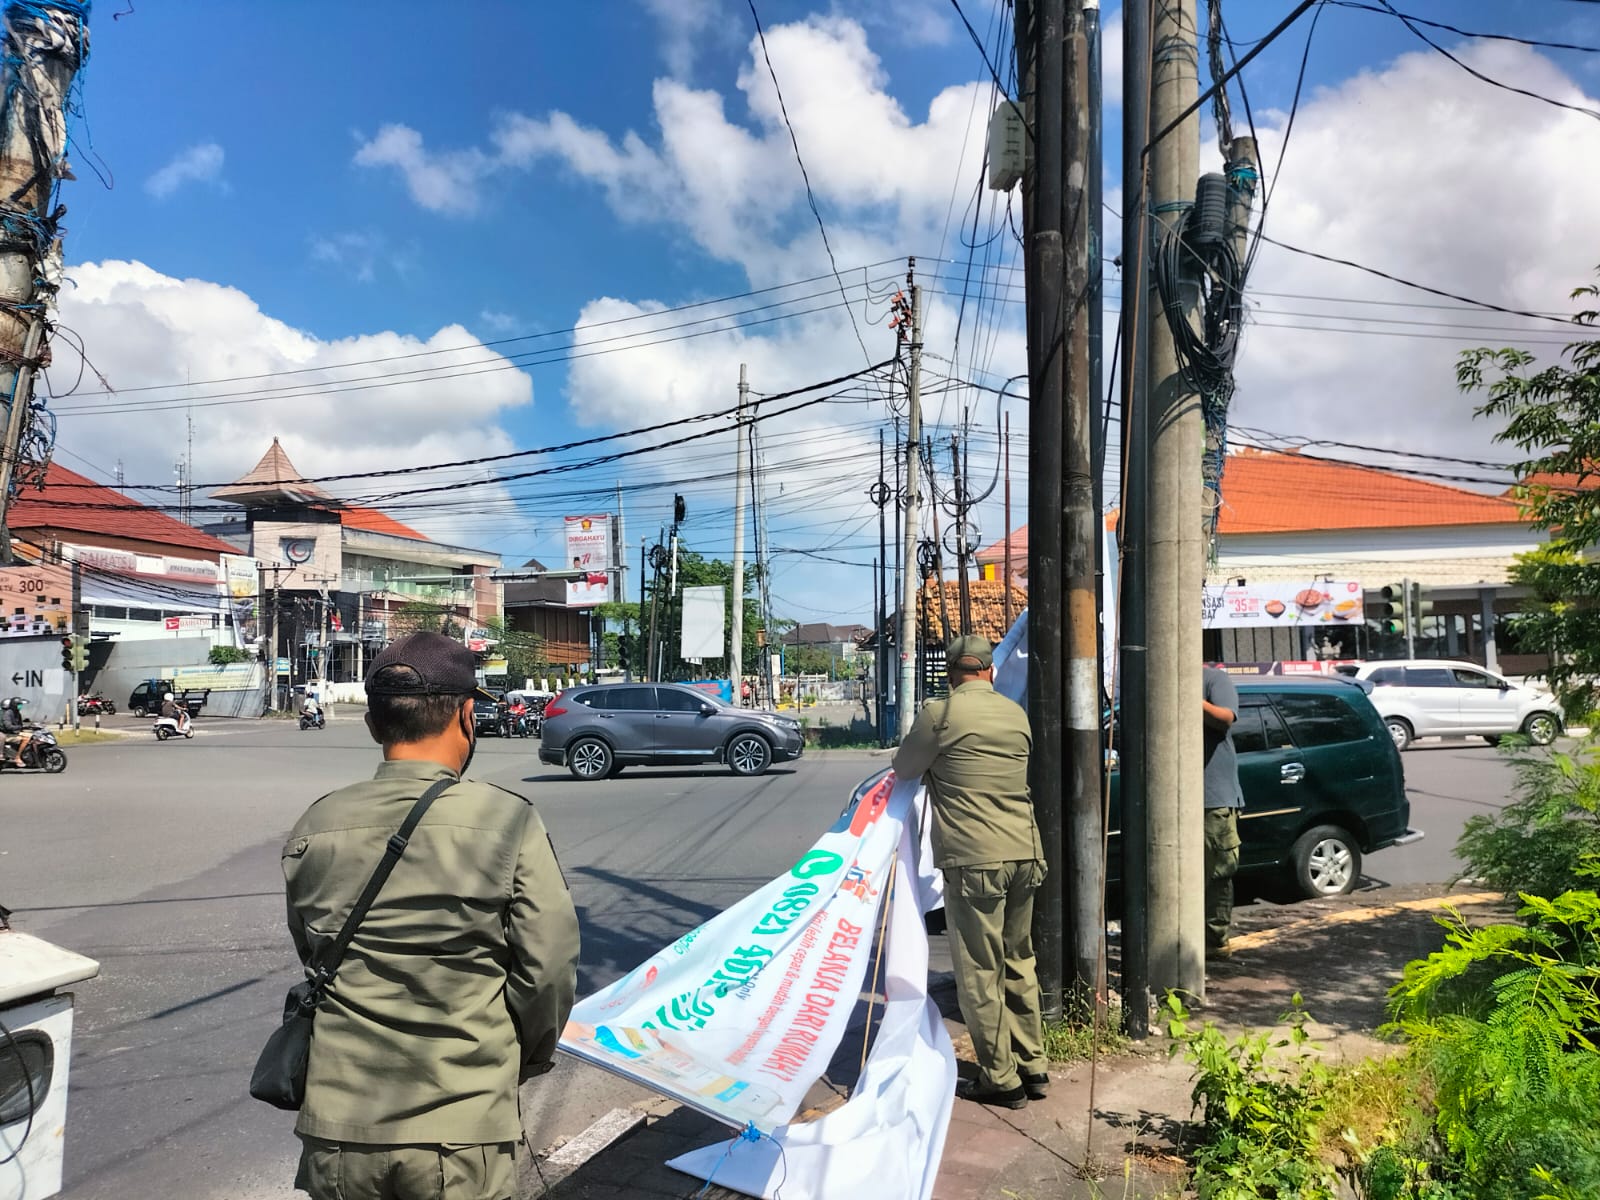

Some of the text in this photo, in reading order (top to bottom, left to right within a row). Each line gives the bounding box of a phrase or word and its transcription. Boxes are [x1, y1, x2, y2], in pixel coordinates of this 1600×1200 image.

[79, 551, 135, 569] DAIHATSU
[19, 580, 43, 593] 300
[1235, 598, 1247, 611] 35
[180, 618, 209, 627] DAIHATSU
[26, 670, 43, 687] IN
[752, 882, 819, 935] 0821
[799, 926, 822, 950] lebih
[788, 948, 808, 972] cepat
[809, 917, 862, 992] BELANJA
[784, 969, 799, 982] &
[772, 979, 797, 1007] mudah
[792, 993, 835, 1031] DARI
